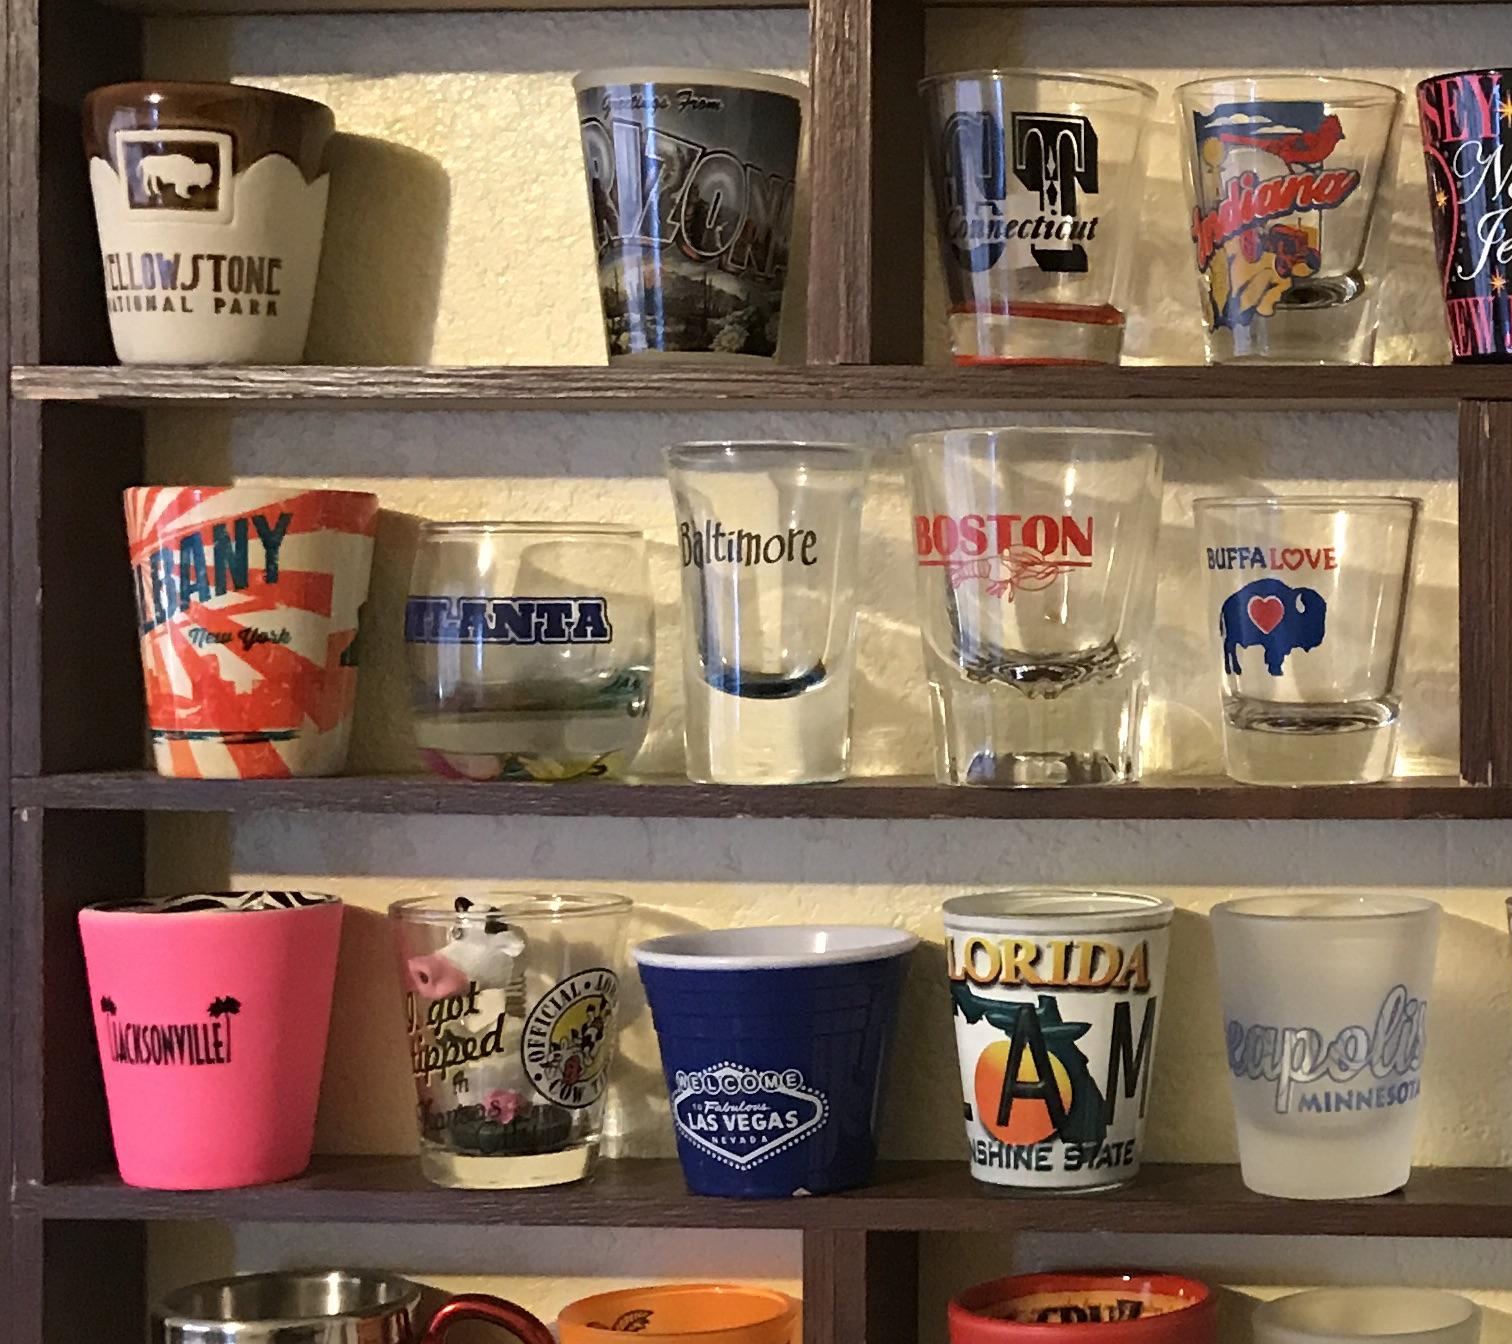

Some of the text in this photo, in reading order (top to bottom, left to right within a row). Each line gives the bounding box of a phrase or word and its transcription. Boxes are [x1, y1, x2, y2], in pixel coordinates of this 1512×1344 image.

[946, 209, 1100, 242] Connecticut
[1191, 169, 1361, 276] Indiana
[107, 253, 282, 296] ELLOWSTONE
[215, 296, 279, 317] PARK
[680, 519, 818, 569] Baltimore
[915, 513, 1095, 558] BOSTON
[188, 625, 293, 652] New York
[945, 935, 1151, 991] LORIDA
[428, 981, 482, 1039] got
[527, 981, 582, 1064] OFFICIAL
[112, 1019, 231, 1067] JACKSONVILLE
[677, 1070, 802, 1094] WELCOME
[687, 1109, 799, 1132] LAS VEGAS
[704, 1099, 770, 1115] Fabulous
[711, 1135, 769, 1145] NEVADA
[1063, 1138, 1136, 1172] STATE
